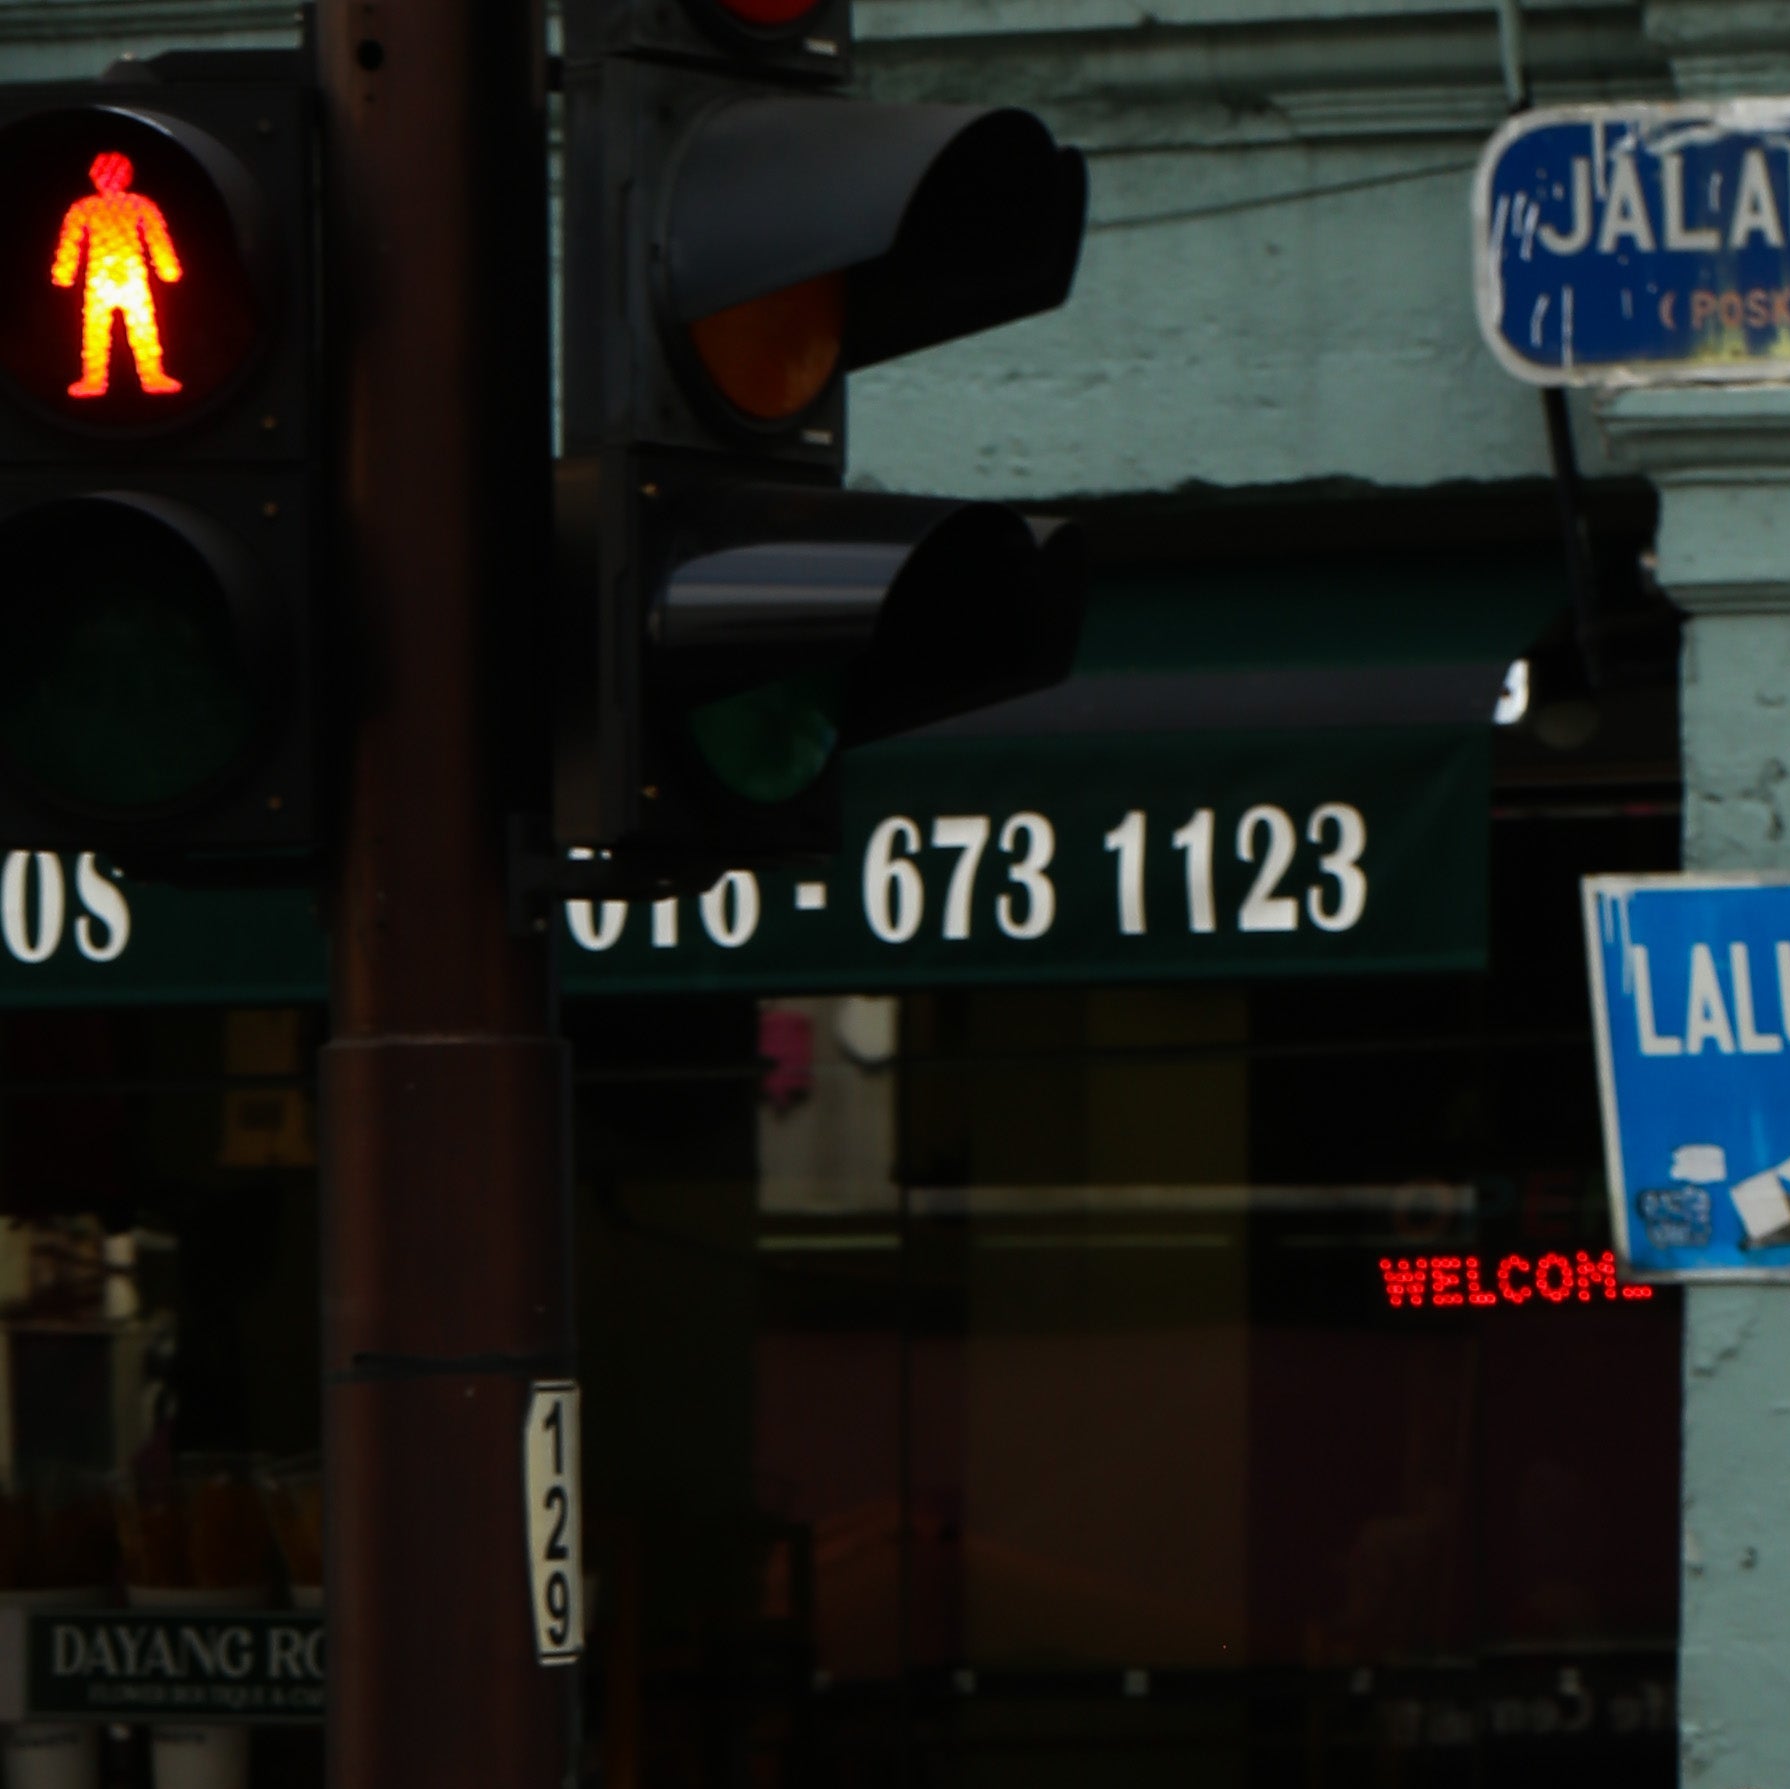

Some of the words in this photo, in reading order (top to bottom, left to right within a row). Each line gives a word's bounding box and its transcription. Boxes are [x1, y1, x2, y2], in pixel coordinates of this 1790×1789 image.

[863, 812, 1056, 943] 673
[1105, 804, 1368, 935] 1123
[1379, 1250, 1652, 1305] WELCOM
[543, 1400, 571, 1648] 129
[52, 1622, 254, 1680] DAYANG
[266, 1625, 325, 1680] RO
